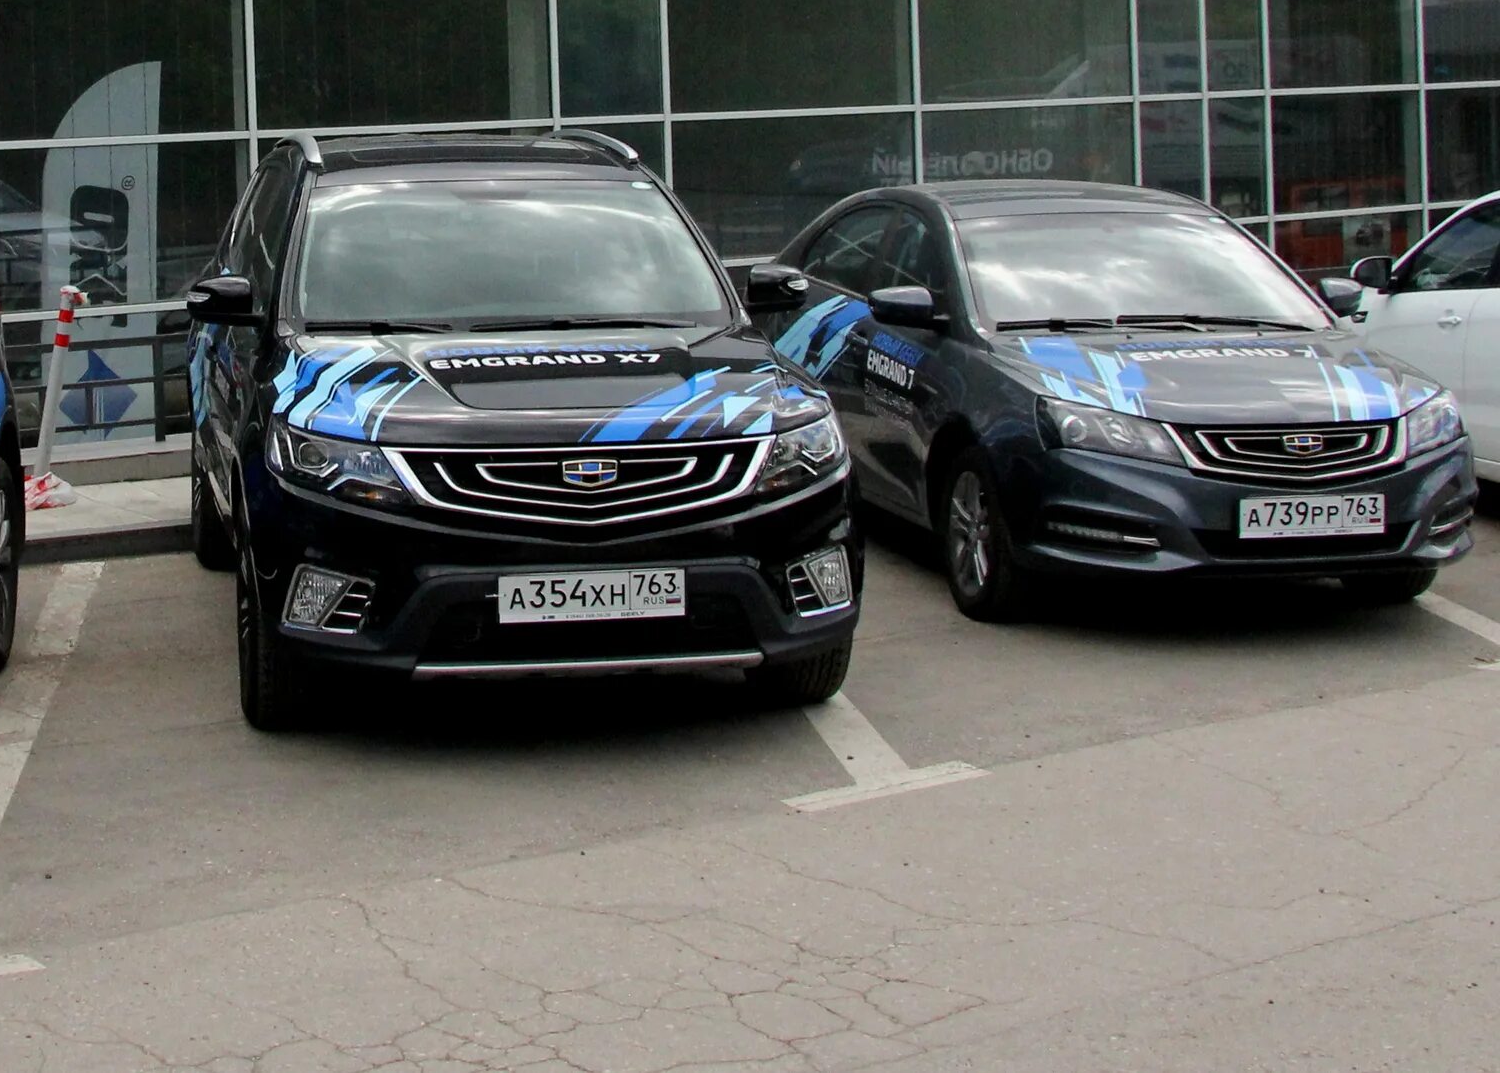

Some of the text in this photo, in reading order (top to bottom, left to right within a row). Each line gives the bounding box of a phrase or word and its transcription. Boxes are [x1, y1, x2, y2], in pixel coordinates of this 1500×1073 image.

[429, 353, 661, 370] EMGRAND X7
[1129, 348, 1289, 362] EMGRAND
[867, 348, 907, 387] EMGRAND
[907, 369, 915, 390] 7
[1248, 497, 1379, 527] А739РР 763
[509, 573, 676, 610] А354ХН 763
[643, 595, 665, 605] RUS
